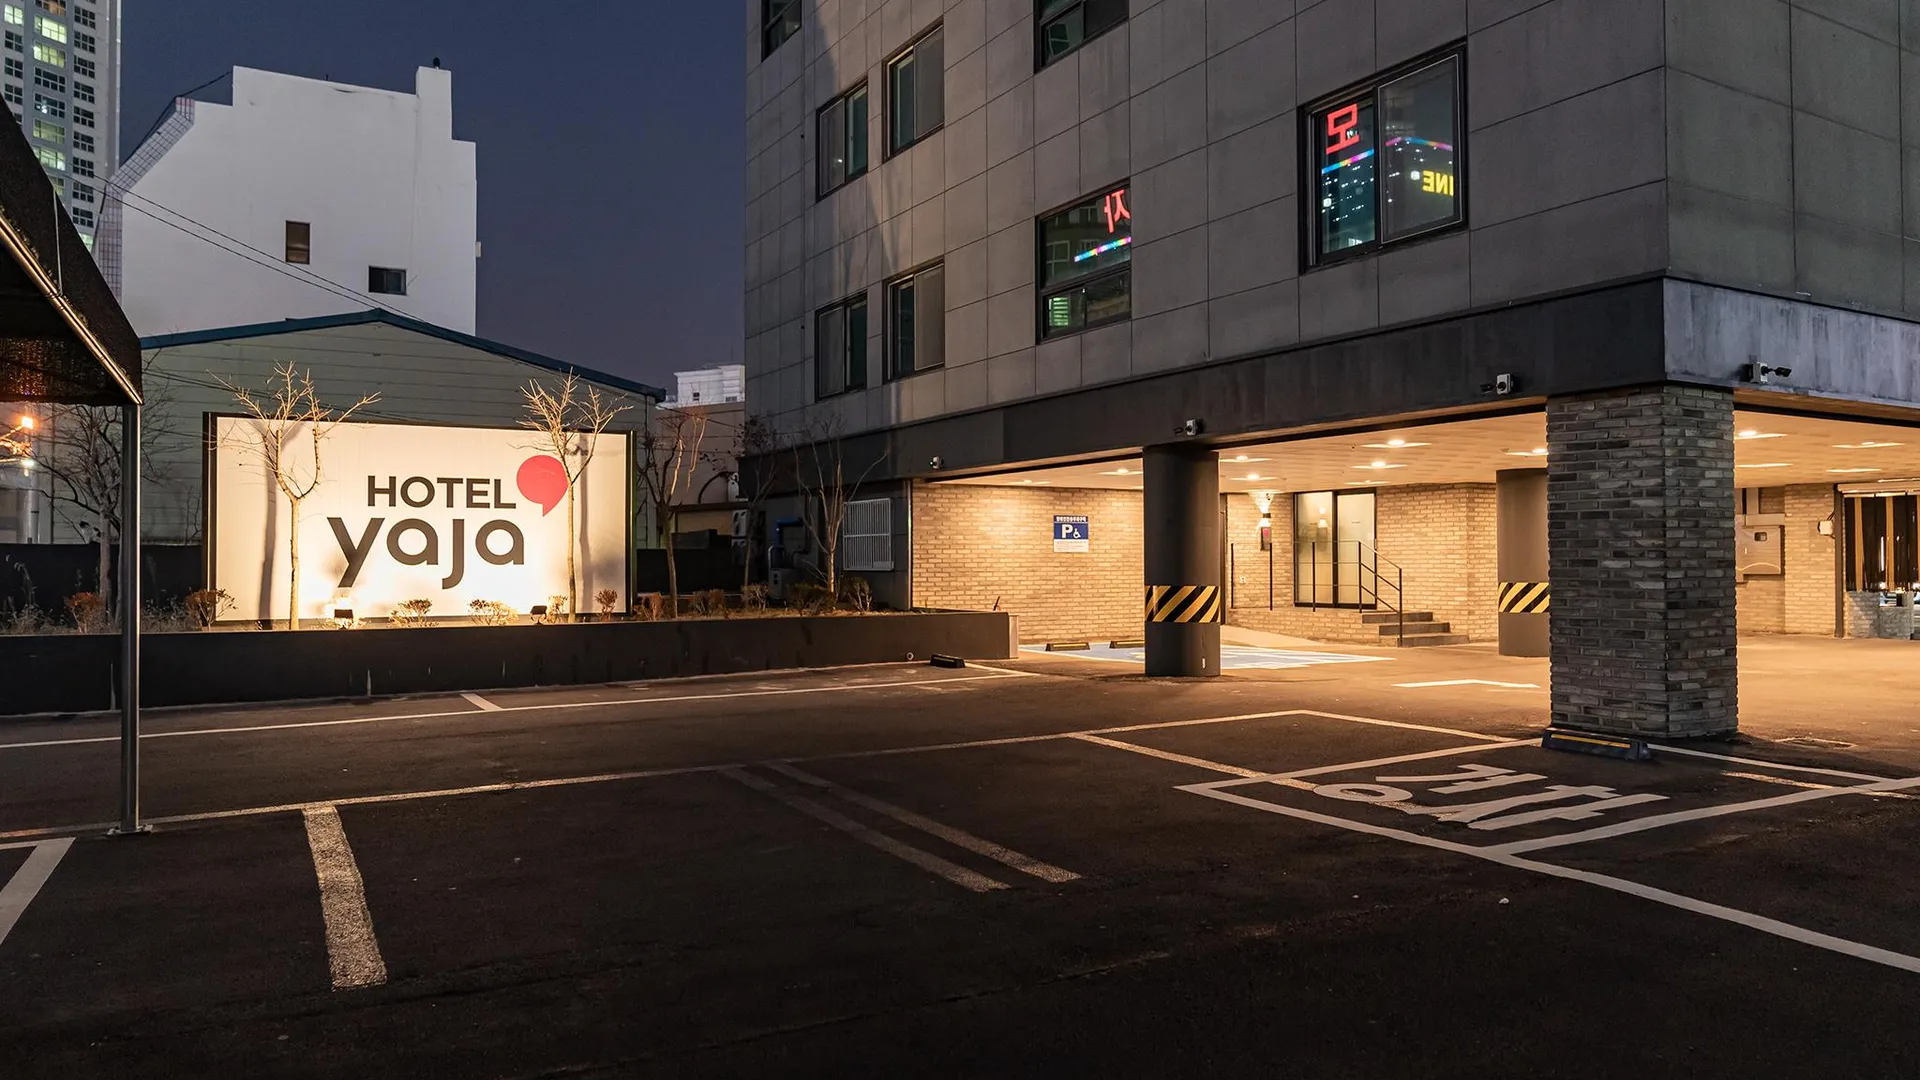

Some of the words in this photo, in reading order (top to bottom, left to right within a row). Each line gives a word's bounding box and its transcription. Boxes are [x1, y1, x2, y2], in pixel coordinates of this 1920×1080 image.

[368, 475, 517, 509] HOTEL
[327, 517, 524, 590] yaja
[1061, 523, 1073, 538] P
[1313, 763, 1670, 831] 경차
